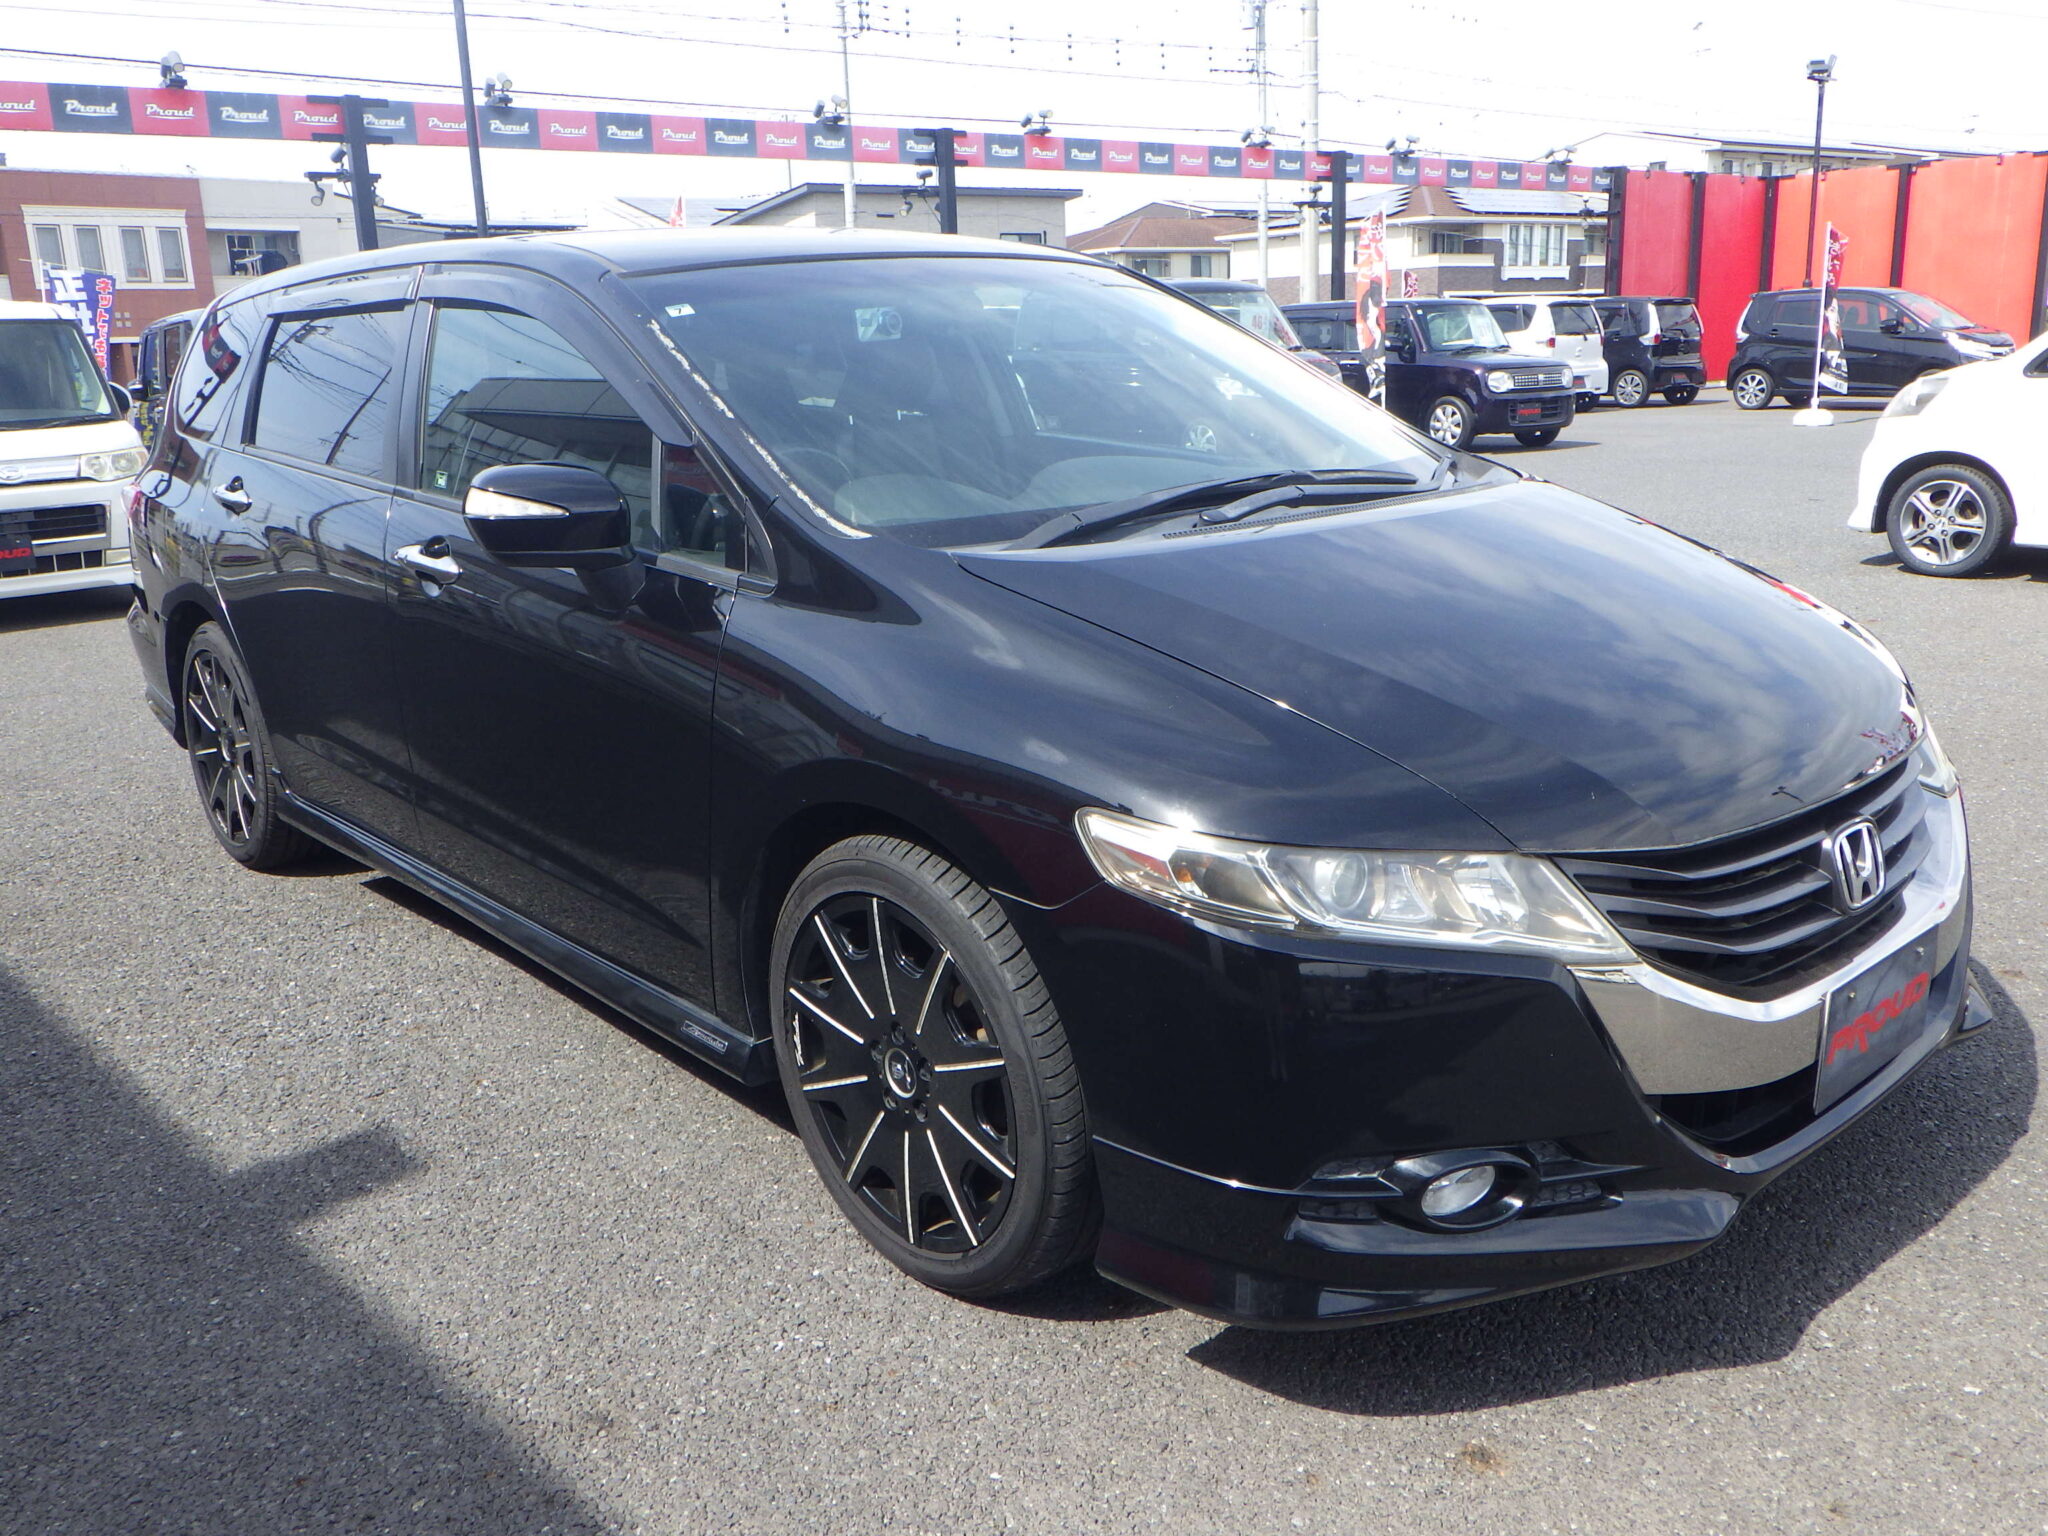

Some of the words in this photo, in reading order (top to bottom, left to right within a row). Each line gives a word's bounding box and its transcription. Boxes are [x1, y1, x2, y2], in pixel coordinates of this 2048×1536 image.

[64, 100, 119, 115] Proud
[145, 103, 195, 118] Proud
[219, 106, 269, 121] Proud
[293, 110, 339, 124] Proud
[363, 113, 406, 128] Proud
[489, 119, 530, 133] Proud
[550, 122, 588, 136] Proud
[606, 124, 644, 138] Proud
[662, 128, 697, 140] Proud
[714, 130, 748, 144] Proud
[765, 133, 798, 145] Proud
[813, 135, 846, 148] Proud
[861, 138, 891, 150] Proud
[1826, 971, 1930, 1065] PROUD
